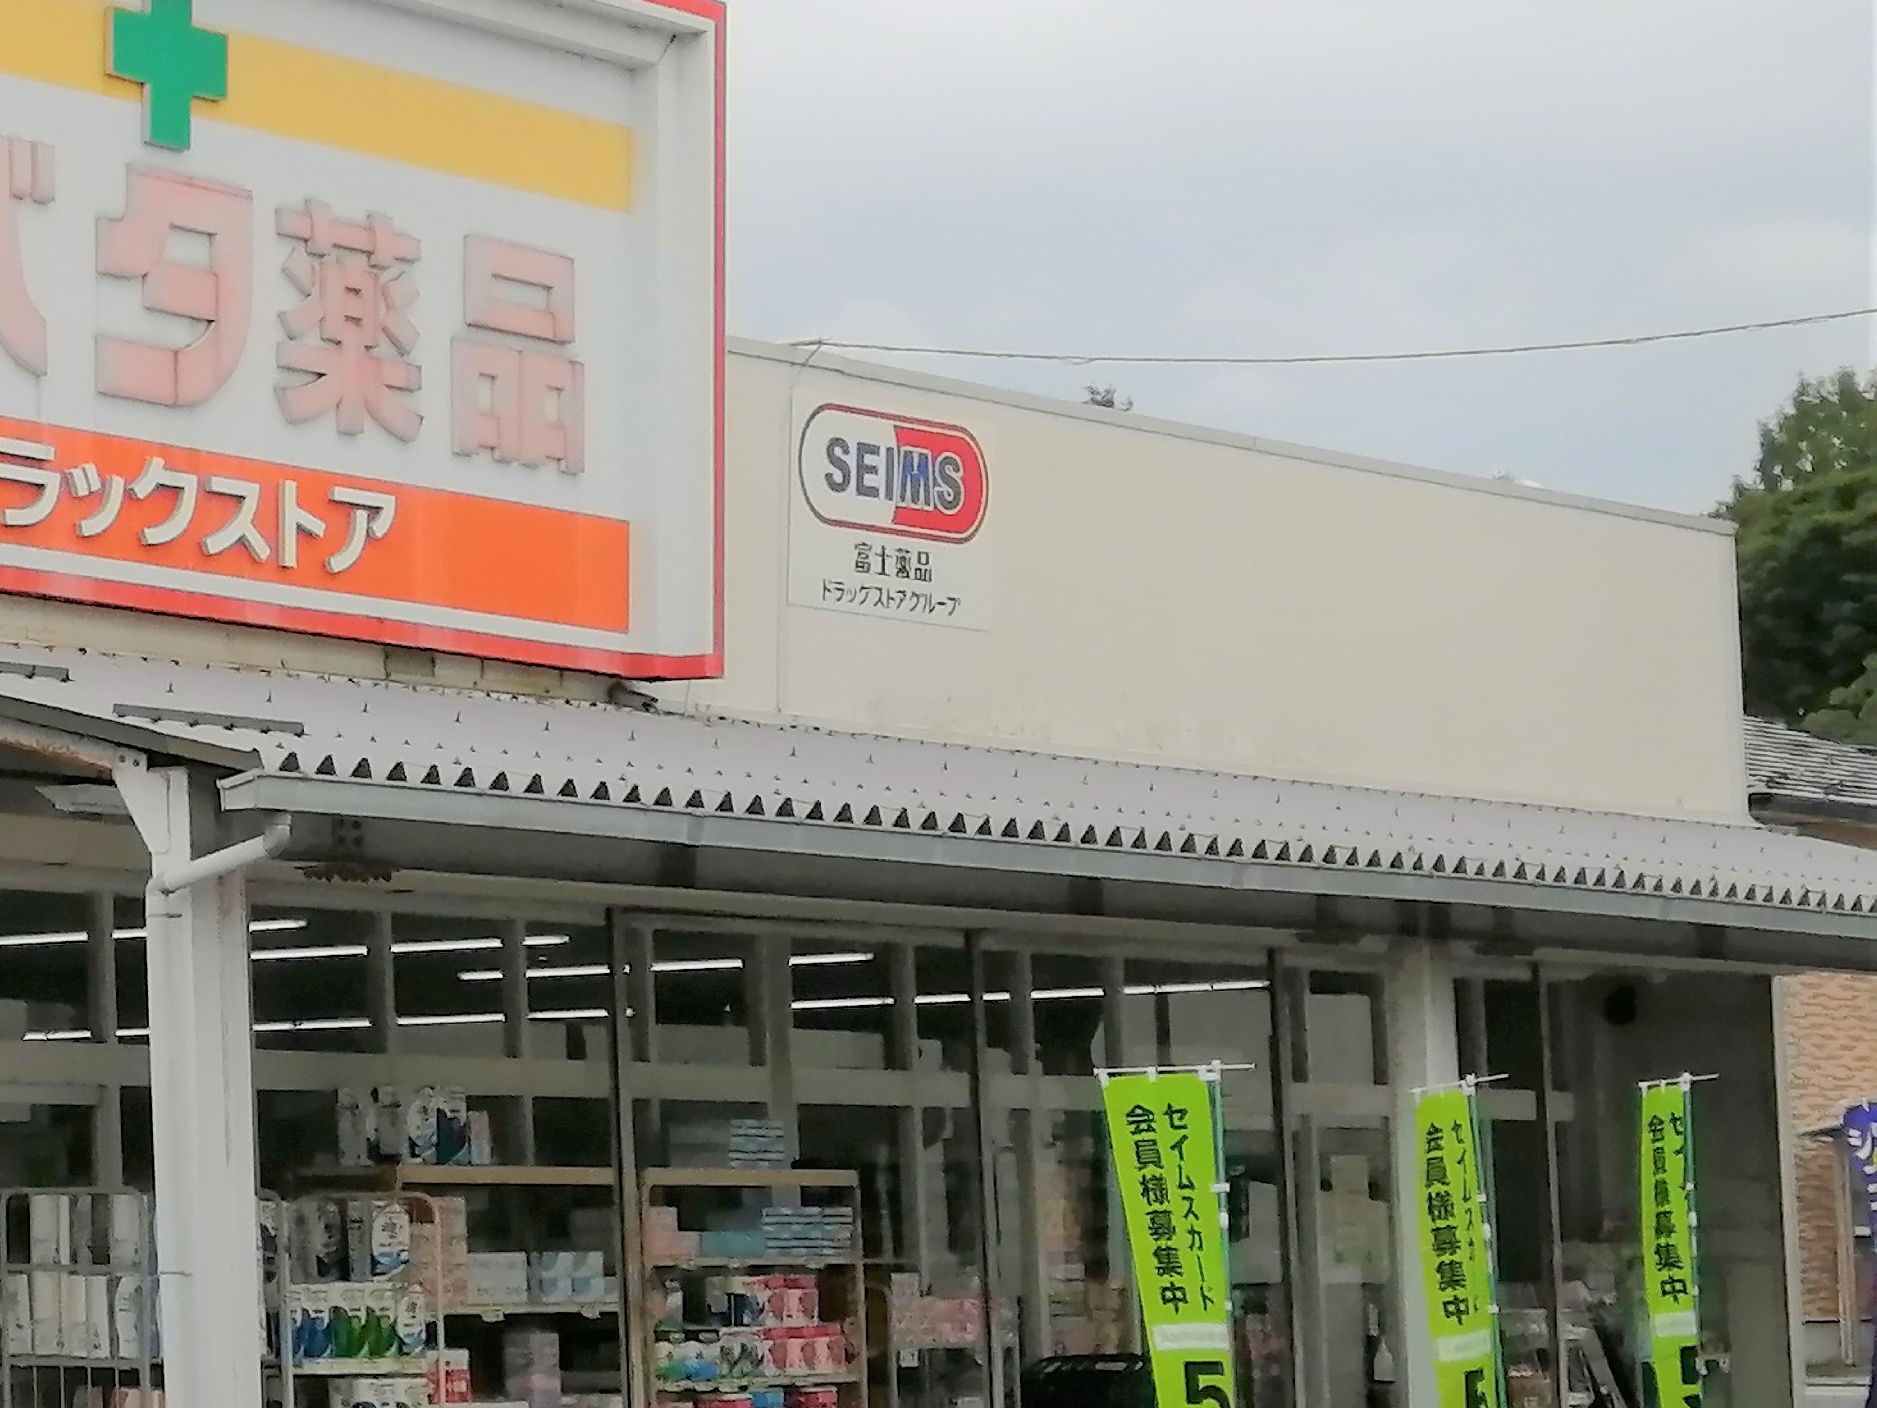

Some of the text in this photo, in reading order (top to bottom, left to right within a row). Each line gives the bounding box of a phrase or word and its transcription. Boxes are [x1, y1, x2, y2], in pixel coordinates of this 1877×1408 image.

[824, 437, 963, 511] SEIMS
[854, 541, 933, 583] 富士薬品
[1125, 1103, 1189, 1315] 会員様募集中
[1163, 1102, 1215, 1312] セイムスカード
